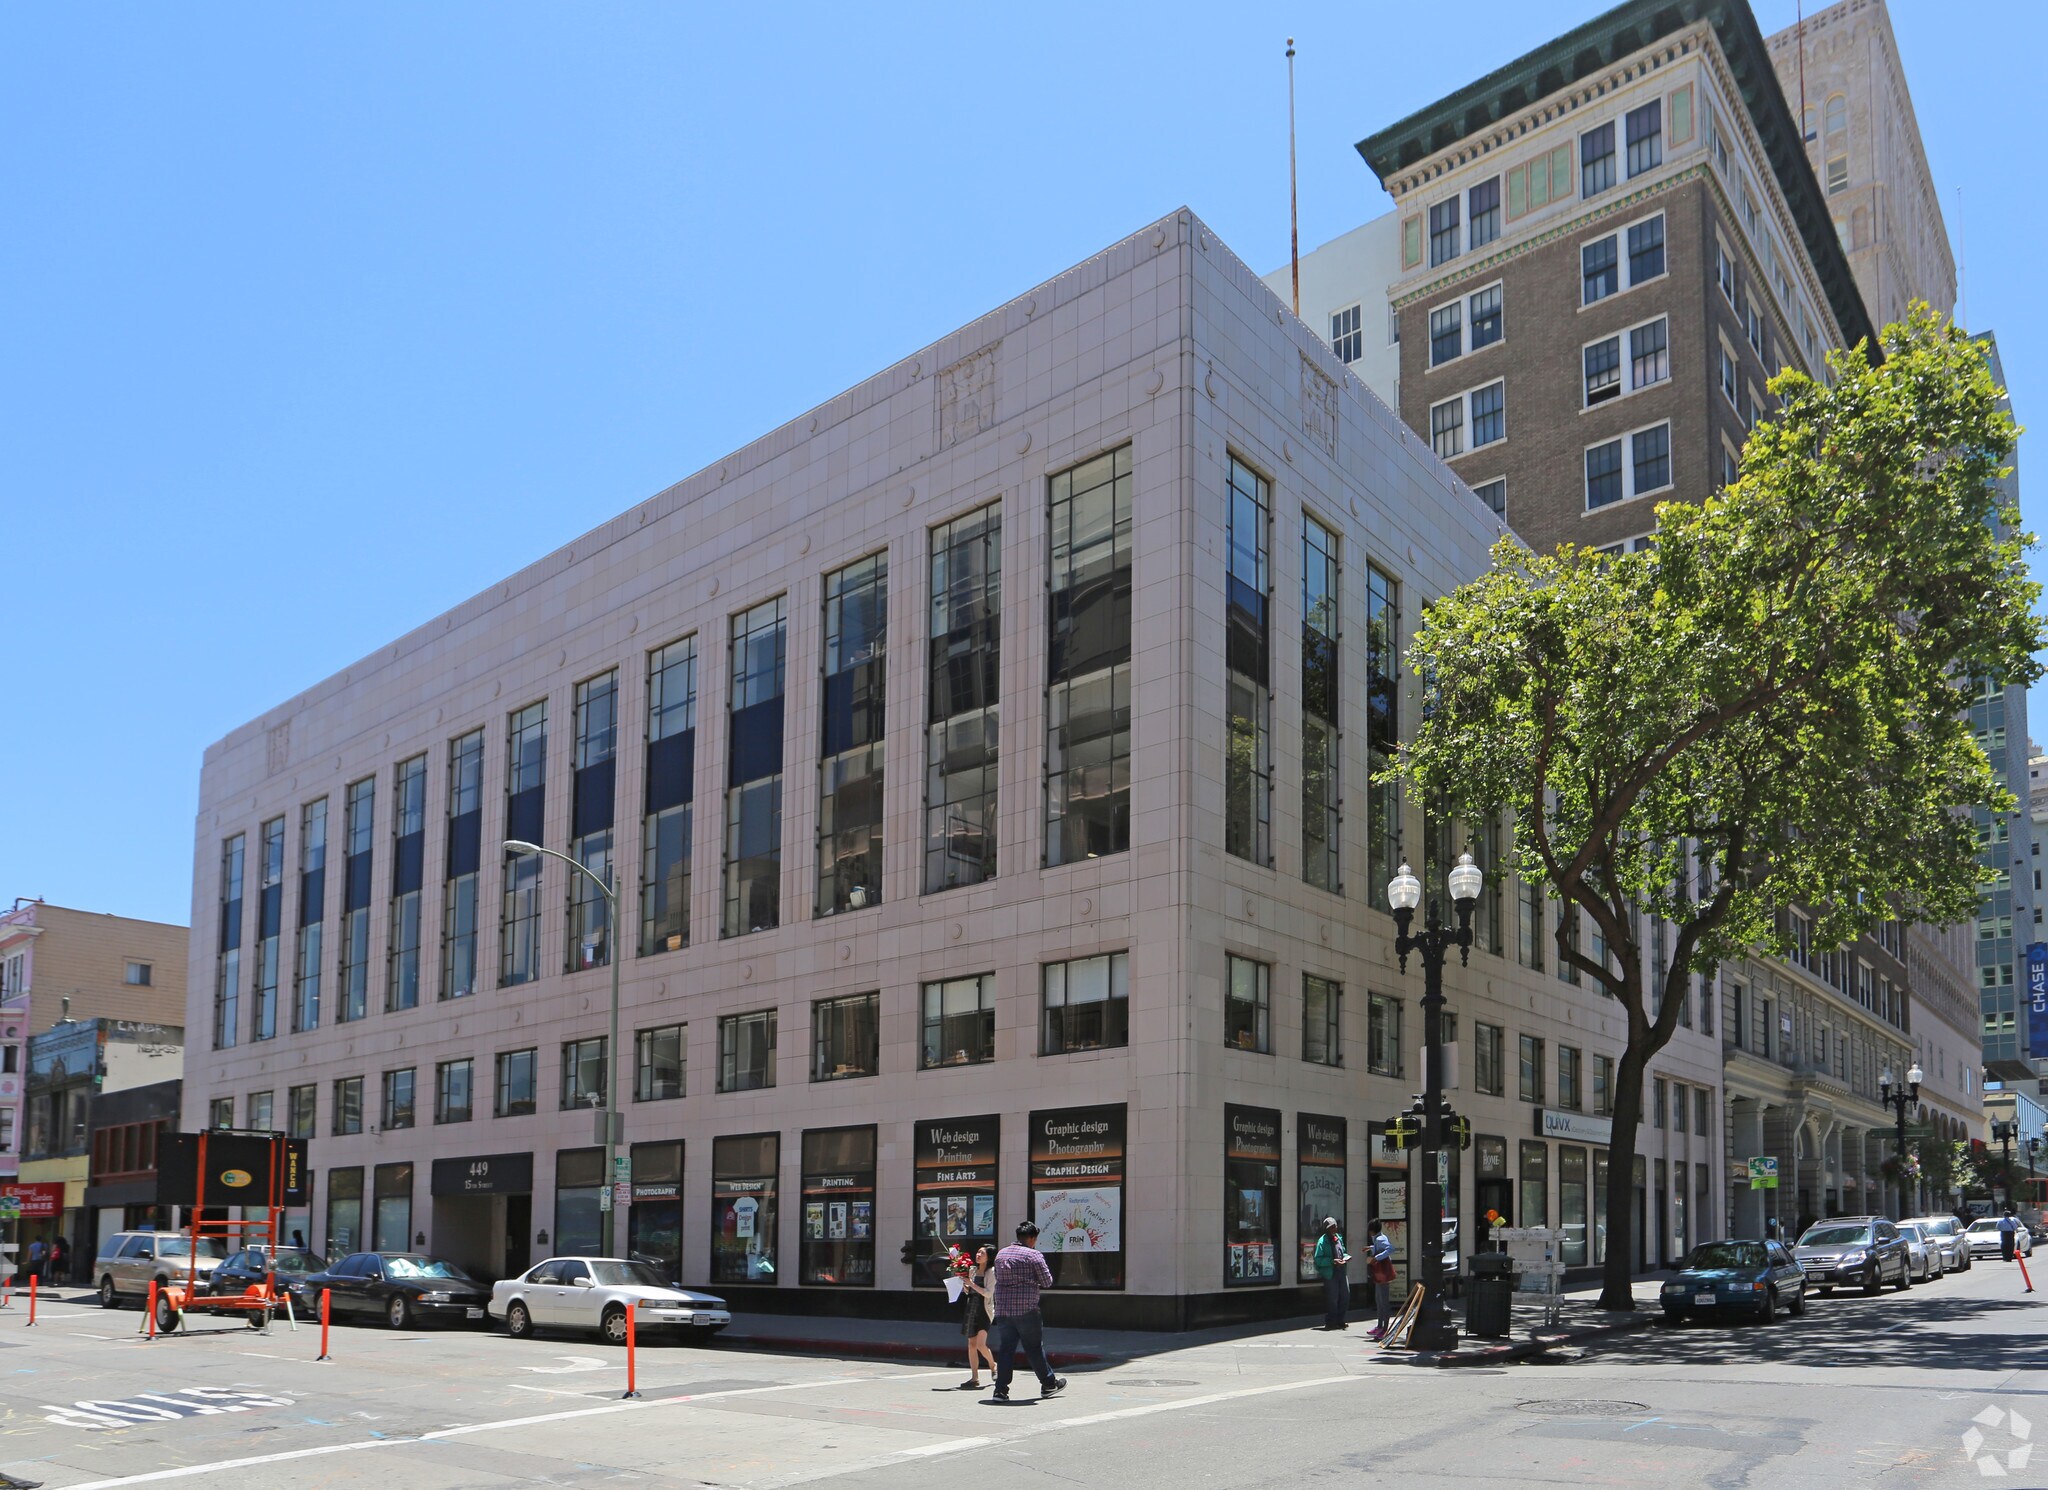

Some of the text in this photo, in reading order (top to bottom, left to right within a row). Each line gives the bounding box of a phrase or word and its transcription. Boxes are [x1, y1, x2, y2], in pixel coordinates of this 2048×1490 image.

[2031, 963, 2046, 1013] CHASE
[1045, 1119, 1109, 1137] Graphic design
[1233, 1115, 1275, 1137] Graphic design
[1307, 1123, 1339, 1143] Web design
[930, 1128, 980, 1144] Web design
[1048, 1139, 1105, 1156] Photography
[1236, 1136, 1272, 1155] Photography
[1312, 1144, 1335, 1161] Printing
[936, 1148, 973, 1164] Printing
[288, 1152, 299, 1189] WANCO
[469, 1161, 489, 1176] 449
[937, 1171, 977, 1181] FINE ARTS
[1045, 1164, 1109, 1176] GRAPHIC DESIGN
[729, 1181, 762, 1191] WEB DESIGN
[822, 1178, 854, 1187] PRINTING
[1301, 1175, 1342, 1197] Oakland
[635, 1187, 677, 1196] PHOTOGRAPHY
